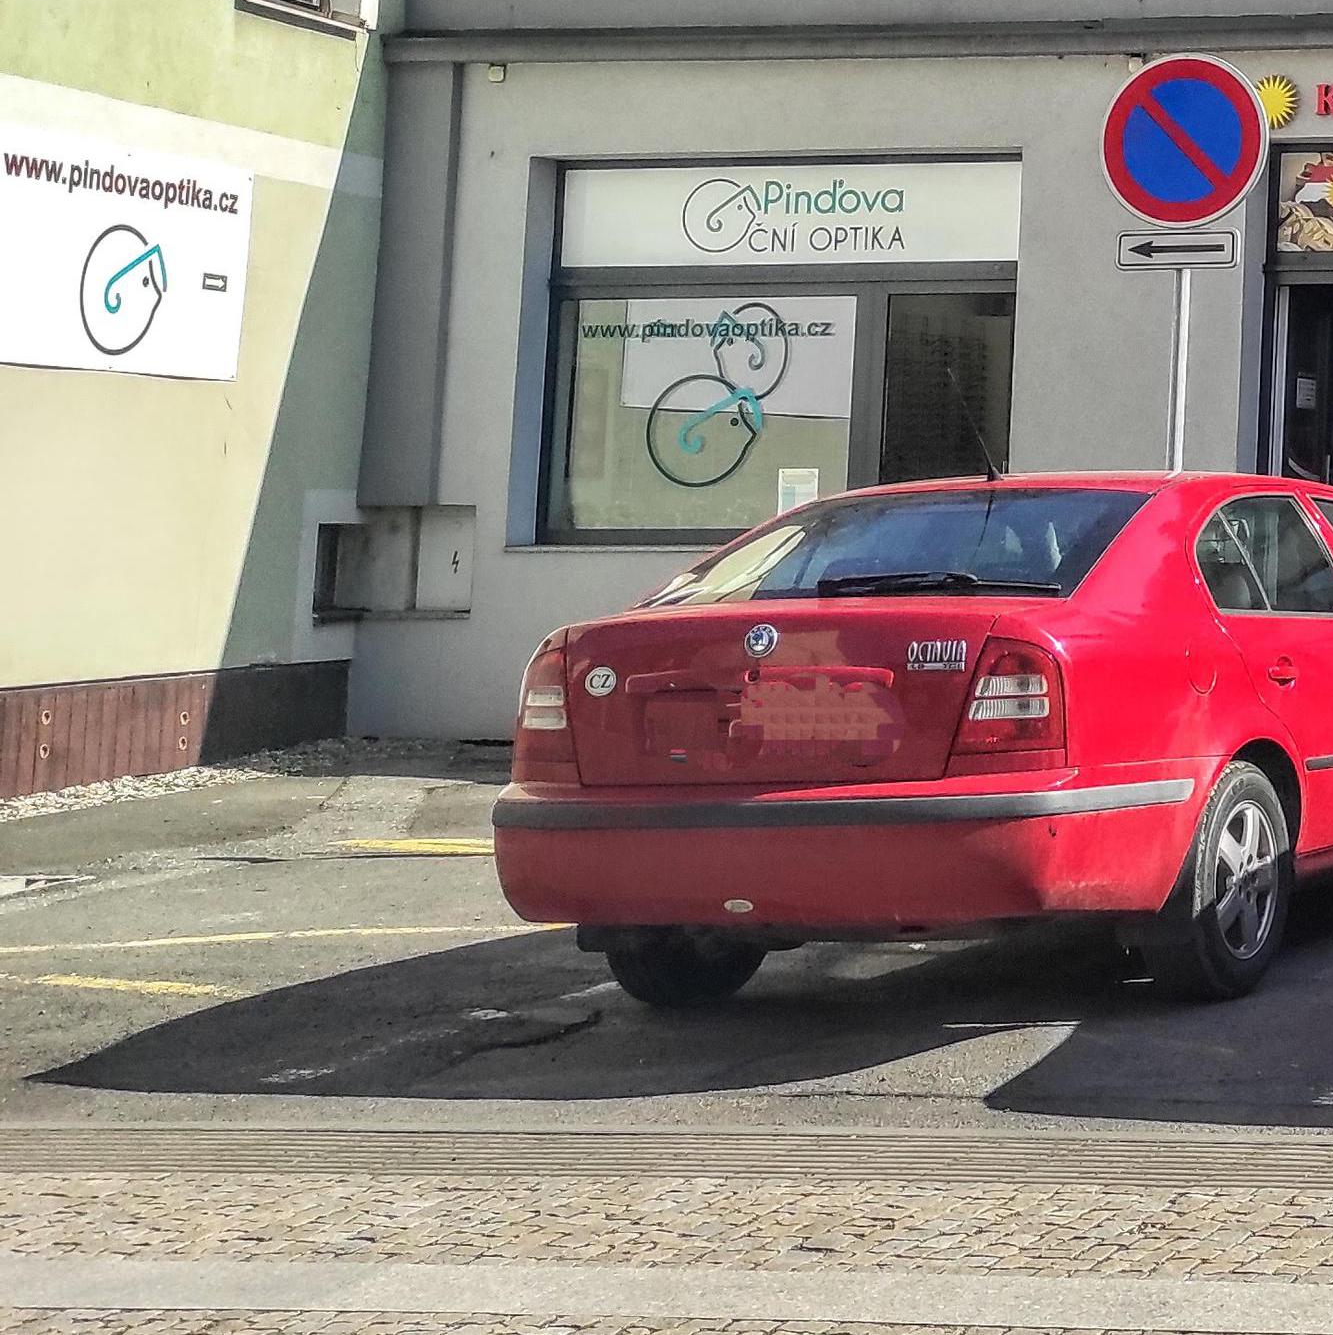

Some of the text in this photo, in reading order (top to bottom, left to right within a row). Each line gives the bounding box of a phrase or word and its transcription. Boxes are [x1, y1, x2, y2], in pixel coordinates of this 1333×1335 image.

[3, 151, 239, 215] www.pindovaoptika.cz
[763, 178, 905, 215] Pinďova
[809, 225, 905, 252] OPTIKA
[907, 639, 967, 663] OCTAVIA
[589, 673, 613, 689] CZ
